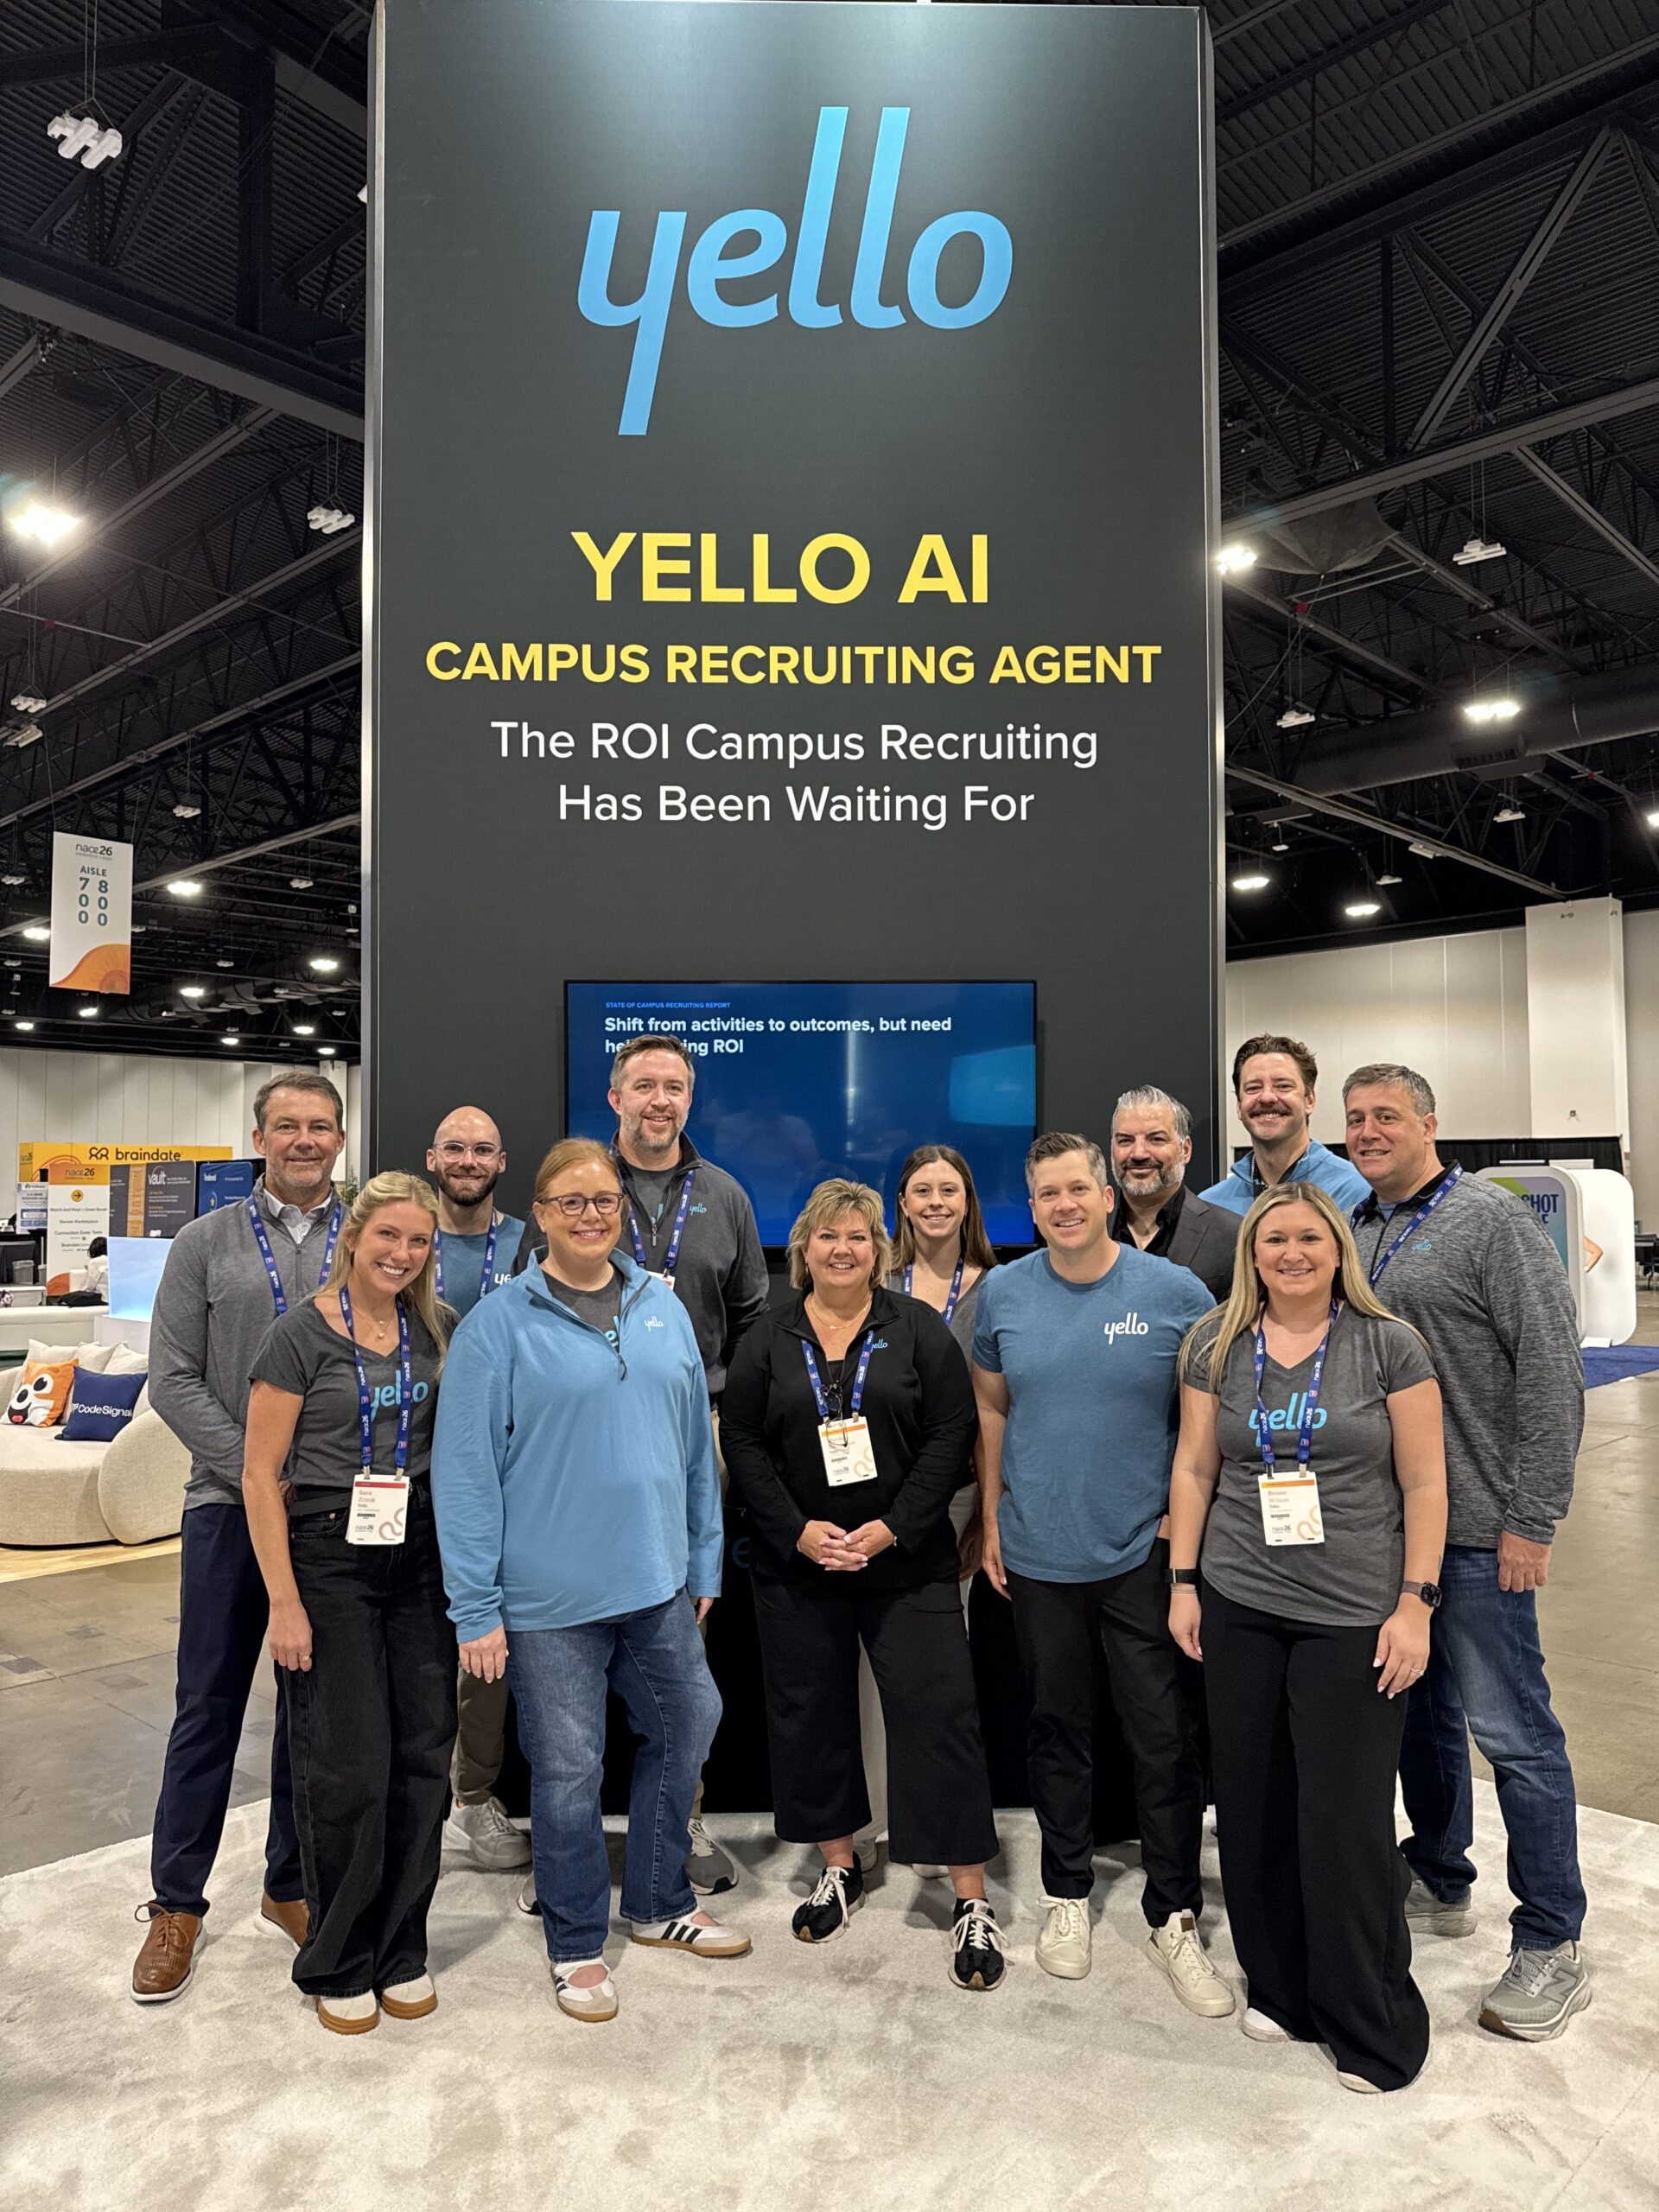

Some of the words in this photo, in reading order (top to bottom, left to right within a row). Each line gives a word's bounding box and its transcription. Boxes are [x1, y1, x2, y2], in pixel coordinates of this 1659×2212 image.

[577, 106, 1013, 435] yello
[570, 531, 871, 605] YELLO
[897, 534, 988, 603] AI
[426, 641, 650, 683] CAMPUS
[667, 645, 975, 684] RECRUITING
[988, 645, 1162, 684] AGENT
[490, 721, 575, 759] The
[592, 722, 669, 760] ROI
[685, 722, 865, 769] Campus
[880, 722, 1097, 769] Recruiting
[559, 784, 643, 822] Has
[659, 785, 771, 822] Been
[785, 785, 947, 831] Waiting
[964, 785, 1035, 822] For
[75, 843, 112, 856] nace26
[80, 866, 107, 877] AISLE
[605, 1016, 644, 1032] Shift
[648, 1017, 687, 1032] from
[691, 1016, 764, 1032] activities
[768, 1018, 785, 1032] to
[790, 1018, 874, 1033] outcomes,
[880, 1017, 907, 1032] but
[912, 1017, 951, 1032] need
[713, 1039, 744, 1053] ROI
[115, 1147, 181, 1161] braindate
[65, 1167, 95, 1177] nace26
[148, 1171, 167, 1185] vault
[690, 1202, 707, 1216] yello
[1411, 1239, 1432, 1253] yello
[644, 1315, 664, 1332] yello
[1103, 1312, 1149, 1345] yello
[369, 1370, 429, 1423] yelo
[78, 1403, 132, 1418] CodeSignal
